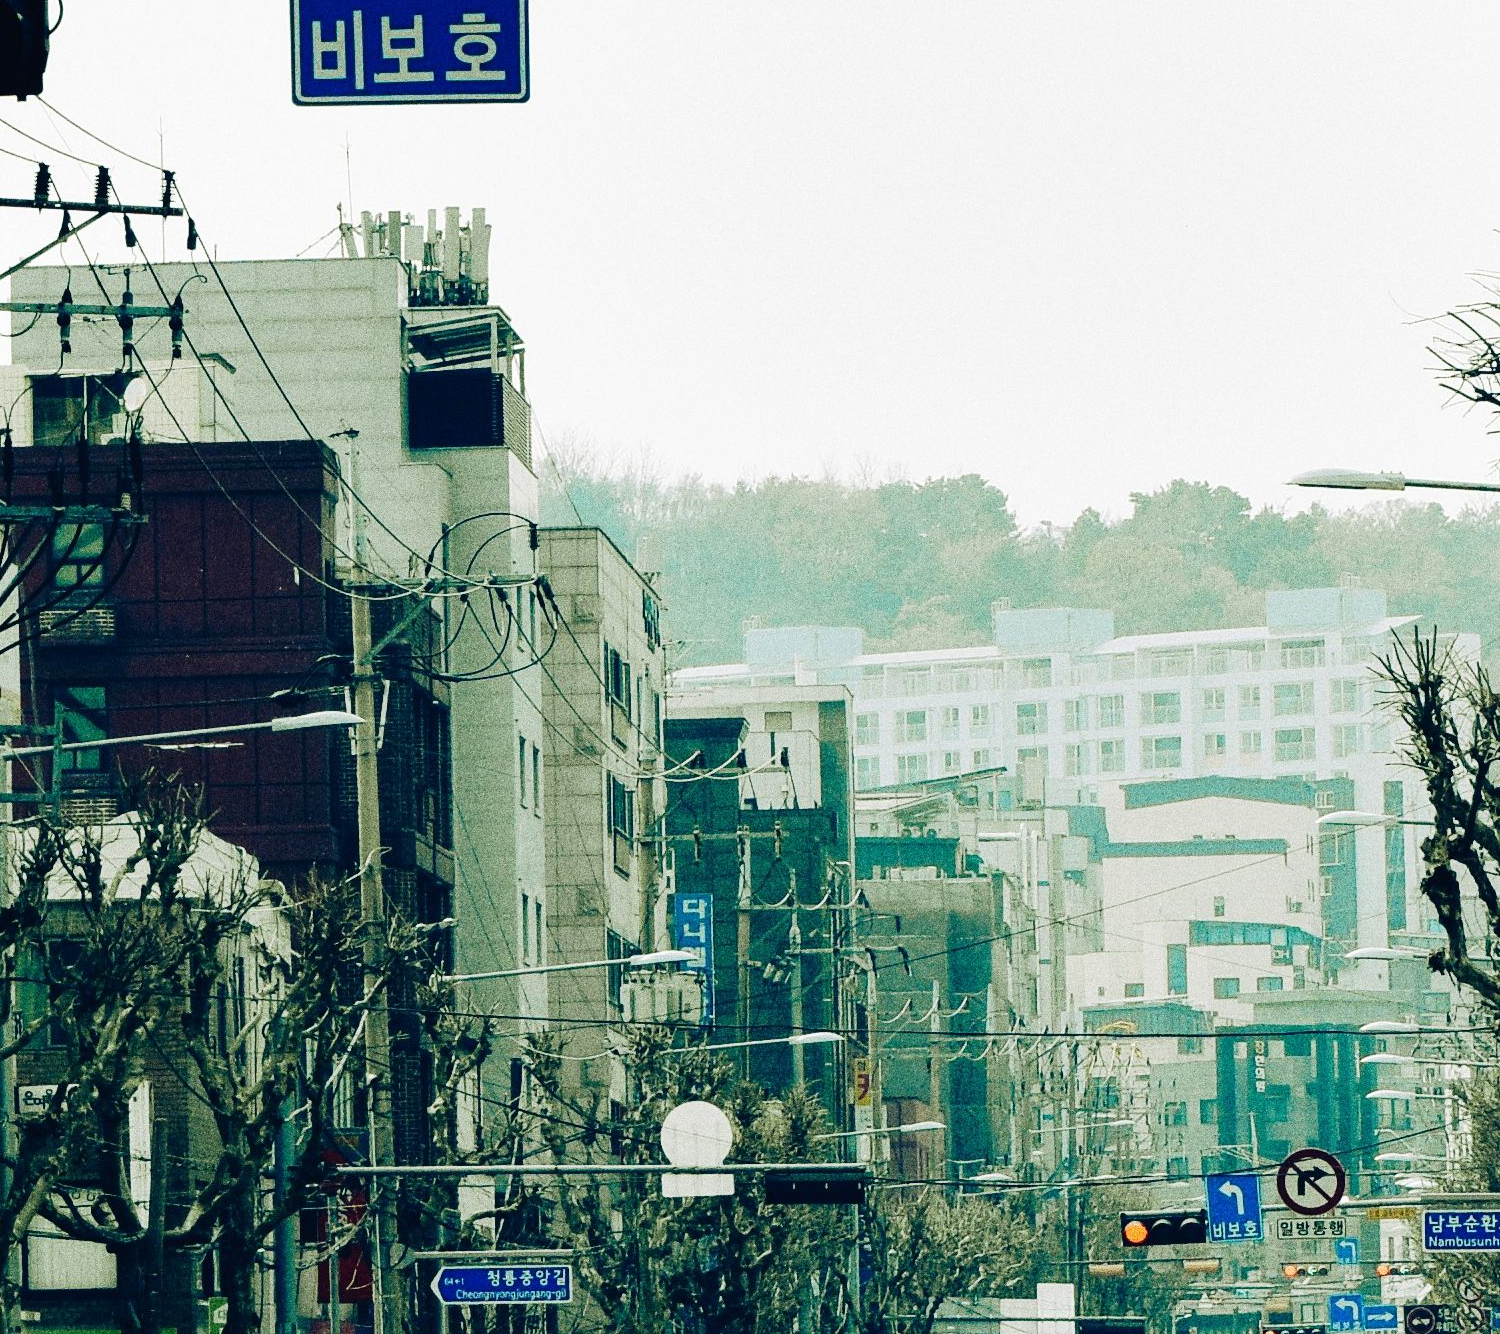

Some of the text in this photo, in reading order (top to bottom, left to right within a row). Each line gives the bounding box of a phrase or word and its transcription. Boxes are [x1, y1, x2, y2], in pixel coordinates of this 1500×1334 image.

[312, 9, 506, 90] 비보호
[1213, 1221, 1258, 1240] 비보호
[1280, 1220, 1344, 1237] 일방통행
[487, 1269, 567, 1287] 청룡중앙길
[455, 1288, 567, 1301] Cheongnyongjungang-gil
